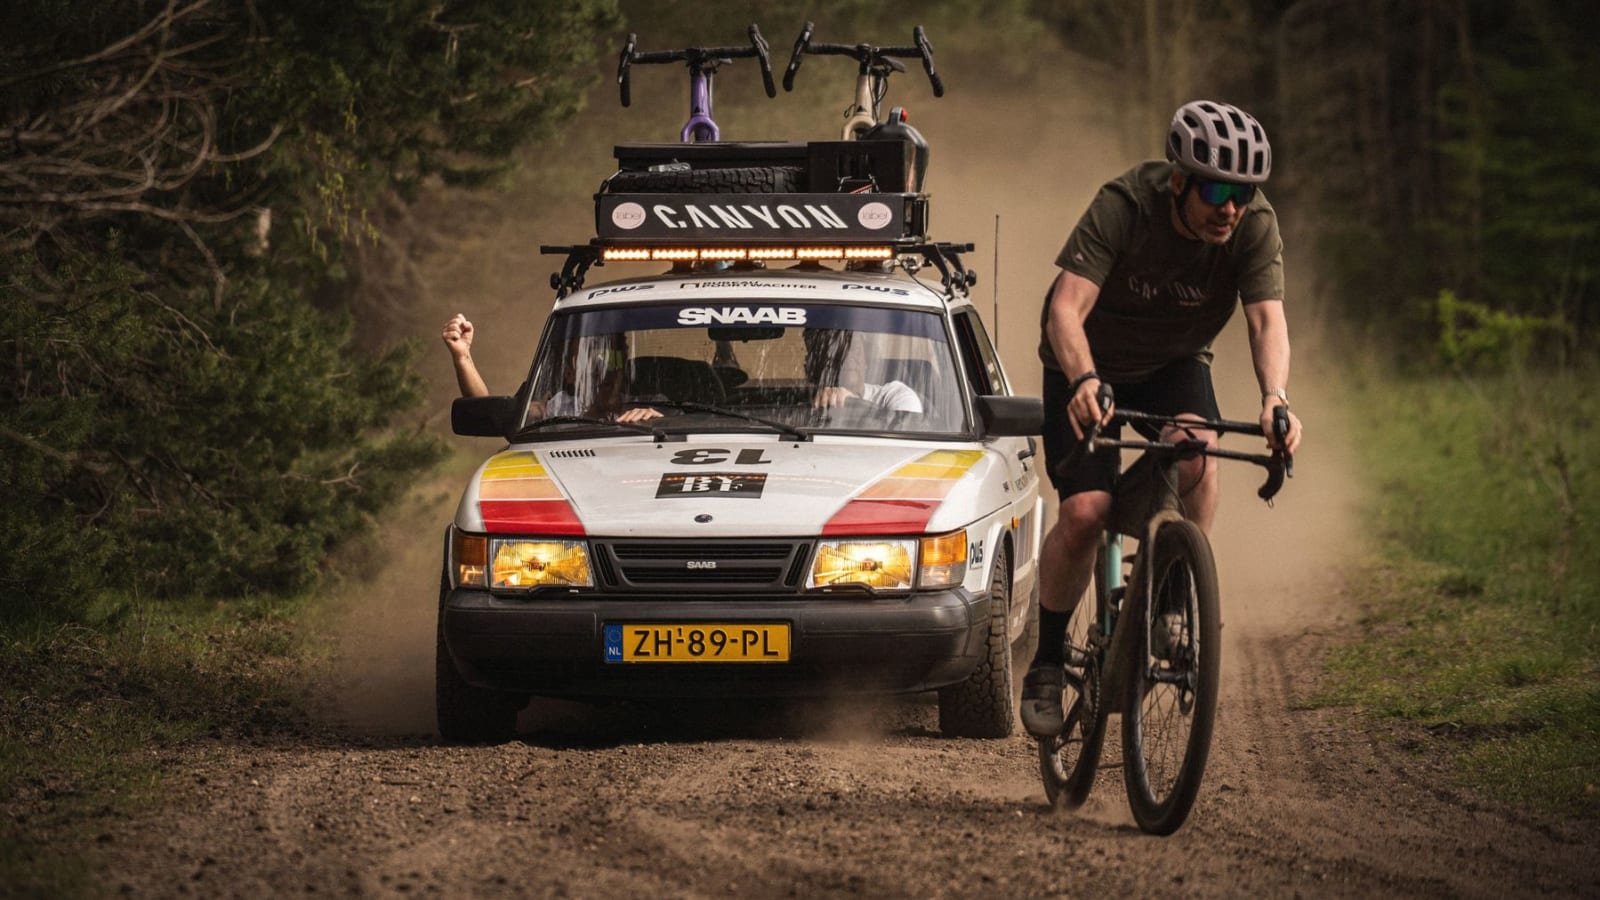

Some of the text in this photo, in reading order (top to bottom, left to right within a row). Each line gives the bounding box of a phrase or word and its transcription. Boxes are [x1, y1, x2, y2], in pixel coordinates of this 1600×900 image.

[653, 204, 848, 229] CANYON
[677, 307, 807, 325] SNAAB
[687, 561, 717, 569] SAAB
[608, 647, 621, 656] NL
